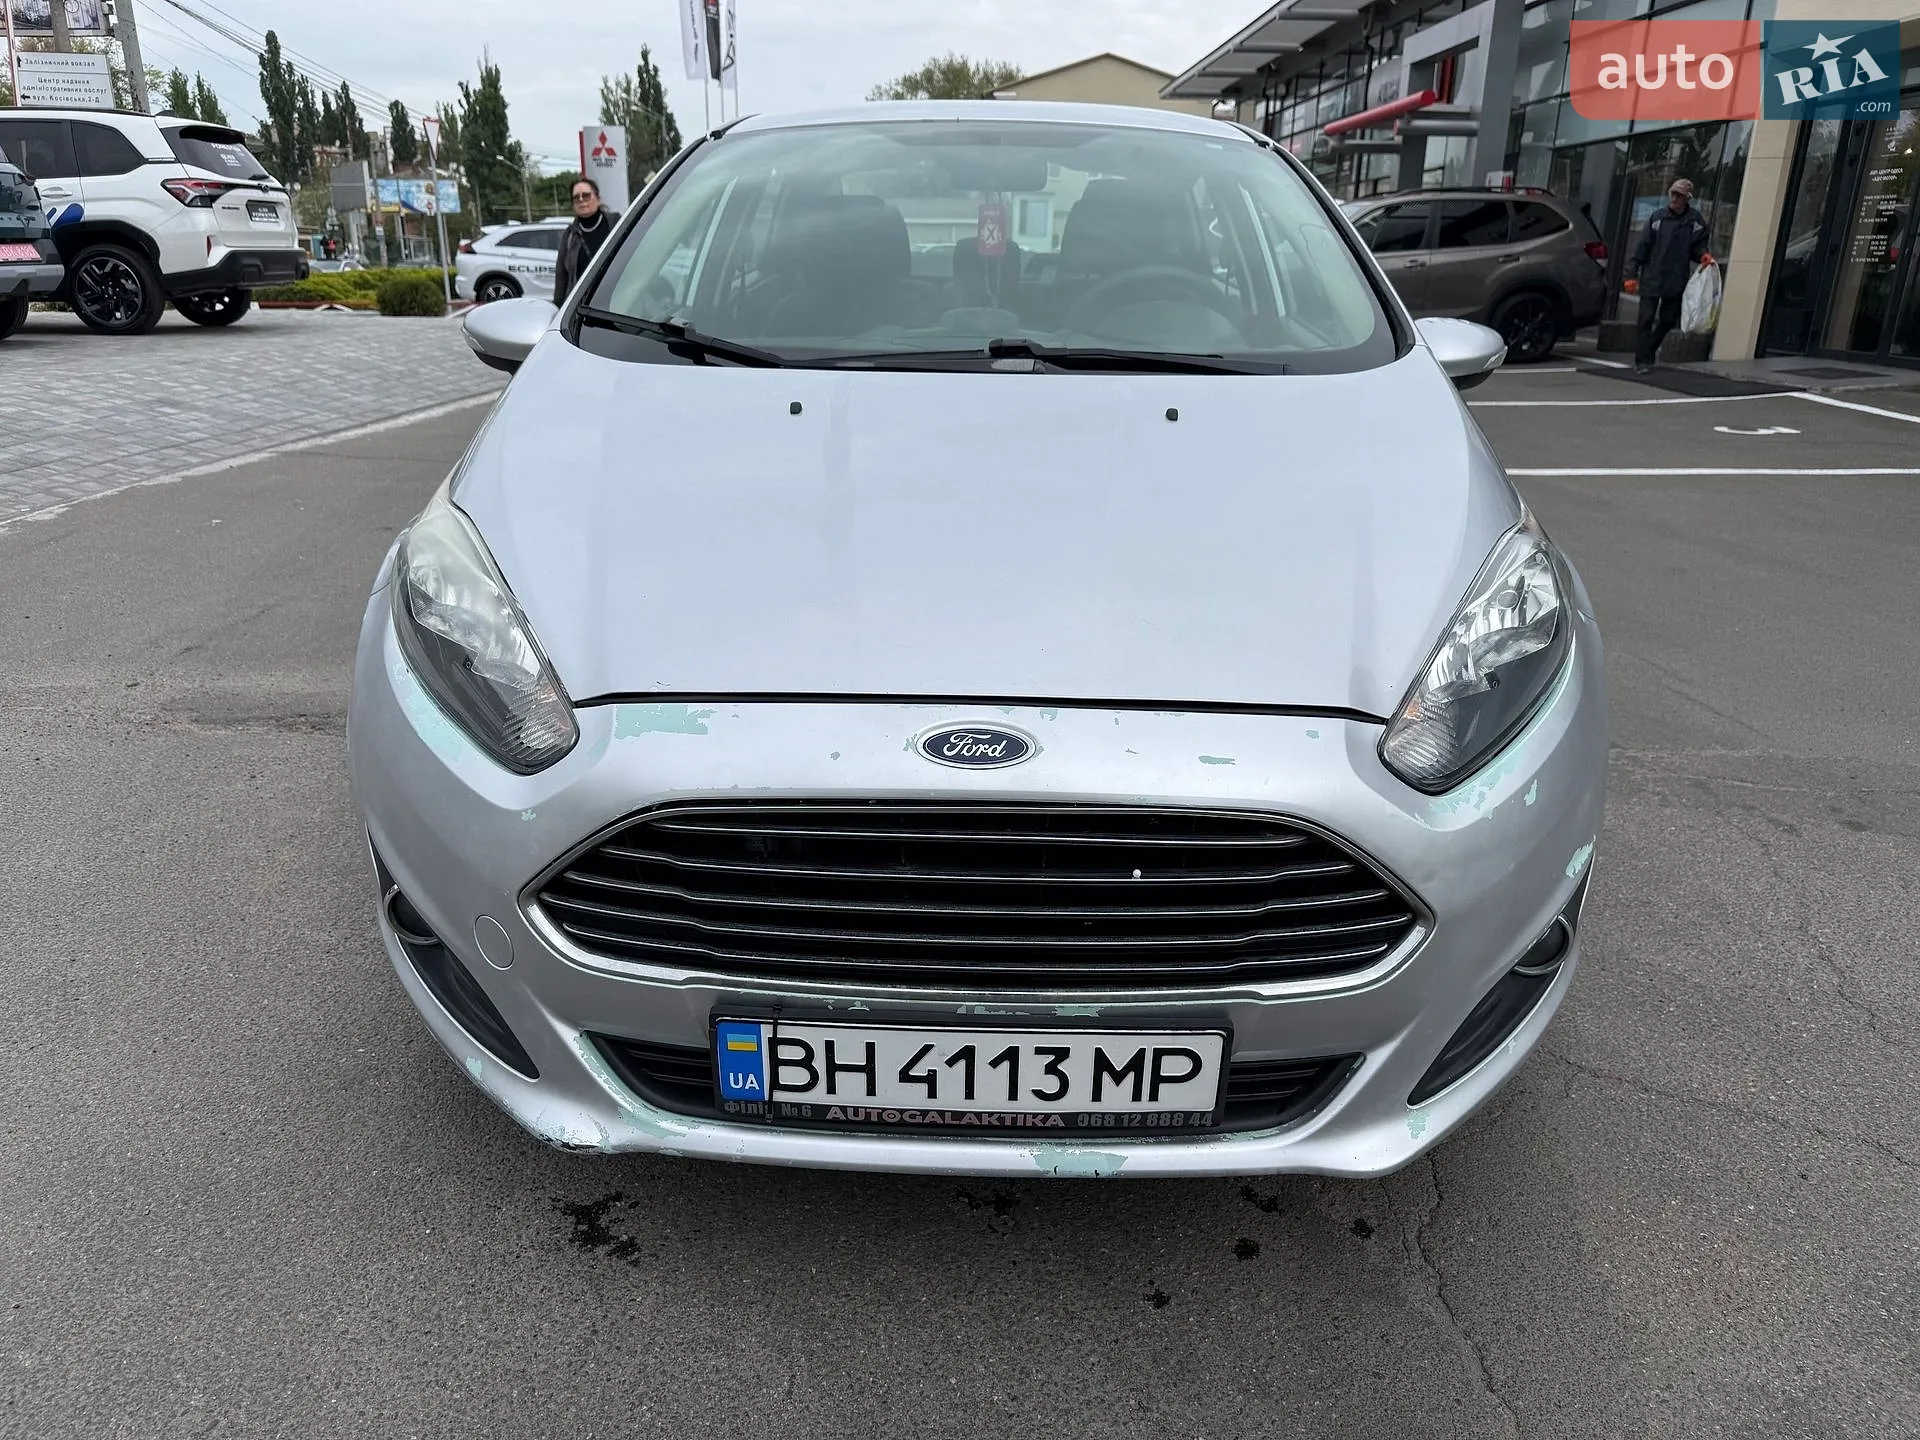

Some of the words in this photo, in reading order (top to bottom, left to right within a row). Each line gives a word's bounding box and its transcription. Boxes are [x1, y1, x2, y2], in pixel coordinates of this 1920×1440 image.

[943, 732, 1008, 757] Ford
[768, 1036, 877, 1097] BH
[898, 1043, 1071, 1102] 4113
[1091, 1046, 1203, 1102] MP
[729, 1072, 760, 1091] UA
[802, 1104, 812, 1117] 6
[825, 1106, 1066, 1127] AUTOGALAKTIKA
[1121, 1113, 1142, 1127] 12
[1146, 1112, 1185, 1127] 888
[1189, 1112, 1213, 1127] 44
